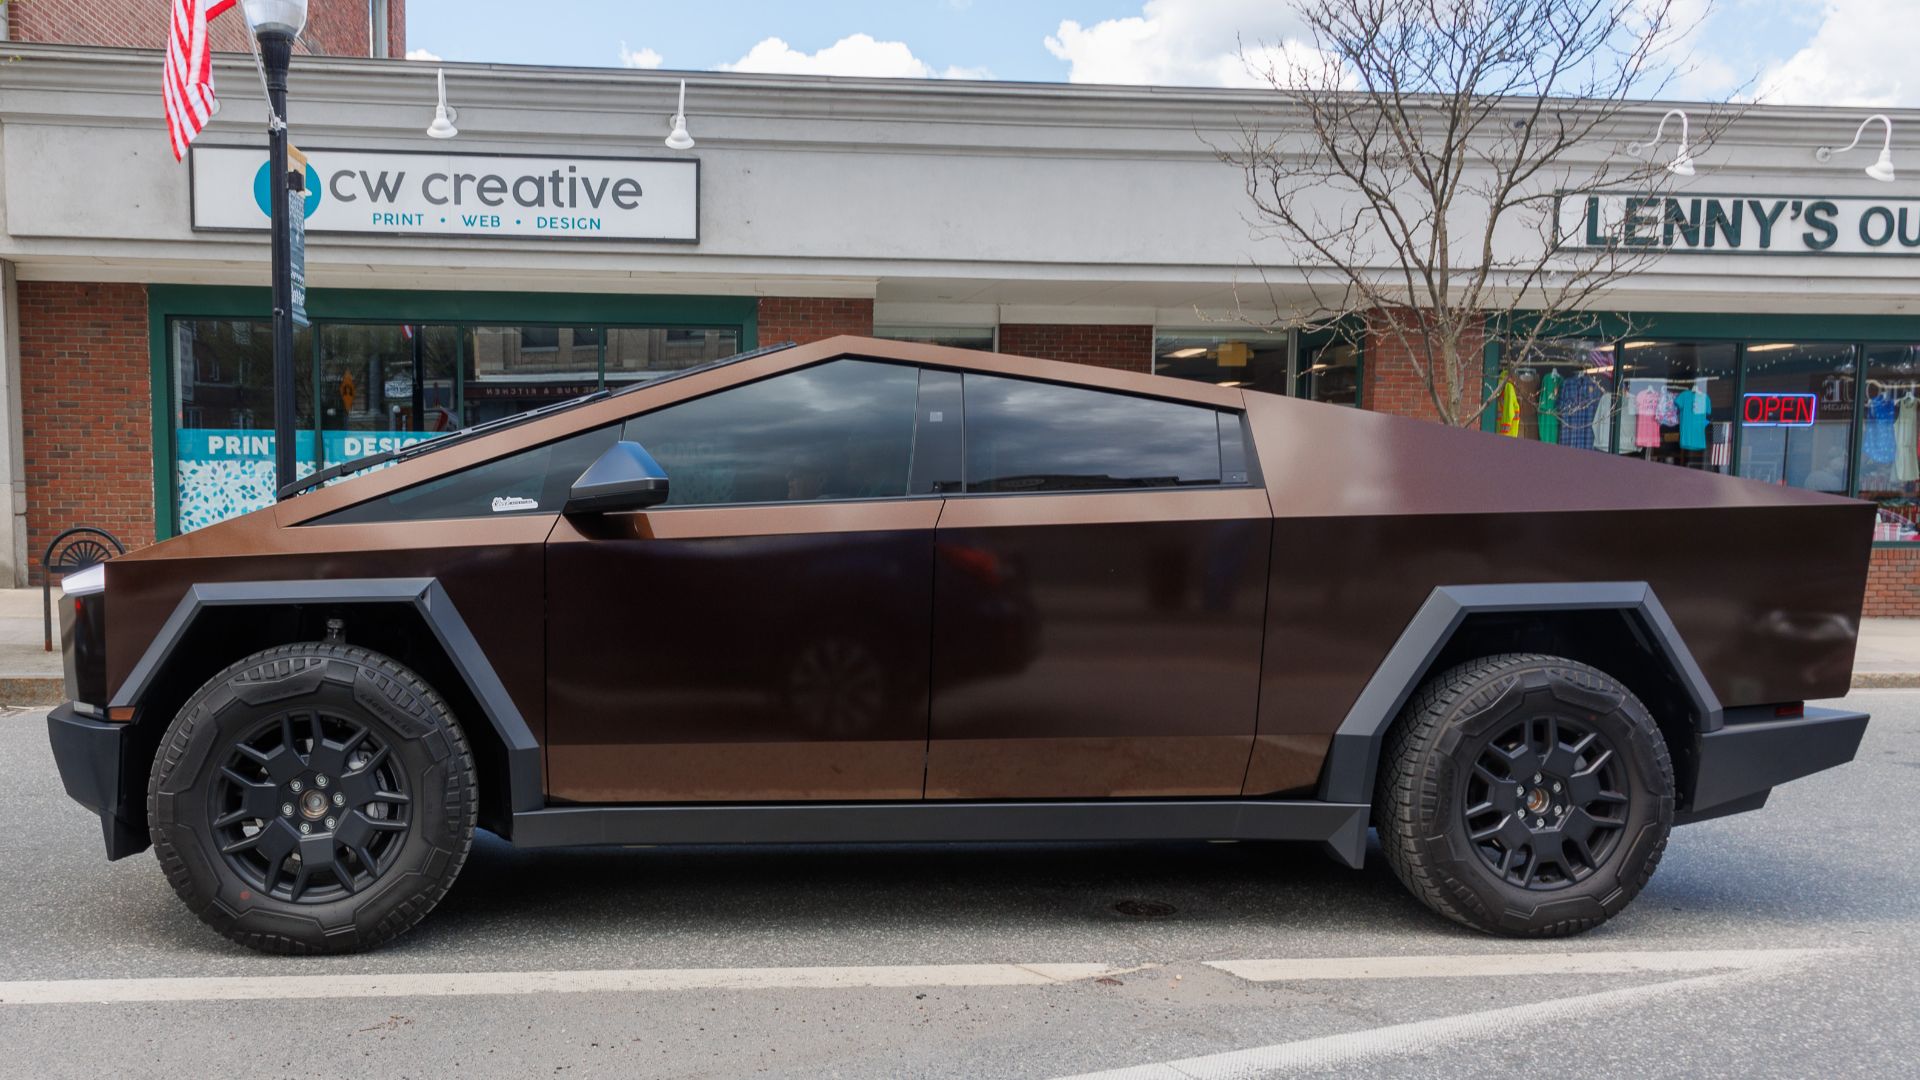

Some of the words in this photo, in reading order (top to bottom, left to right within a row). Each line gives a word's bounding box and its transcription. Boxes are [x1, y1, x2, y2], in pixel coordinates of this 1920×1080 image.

[329, 169, 406, 203] cw
[421, 165, 643, 210] creative
[372, 212, 424, 226] PRINT
[461, 214, 501, 228] WEB
[536, 216, 602, 230] DESIGN
[1586, 196, 1839, 250] LENNY'S
[1744, 396, 1814, 423] OPEN
